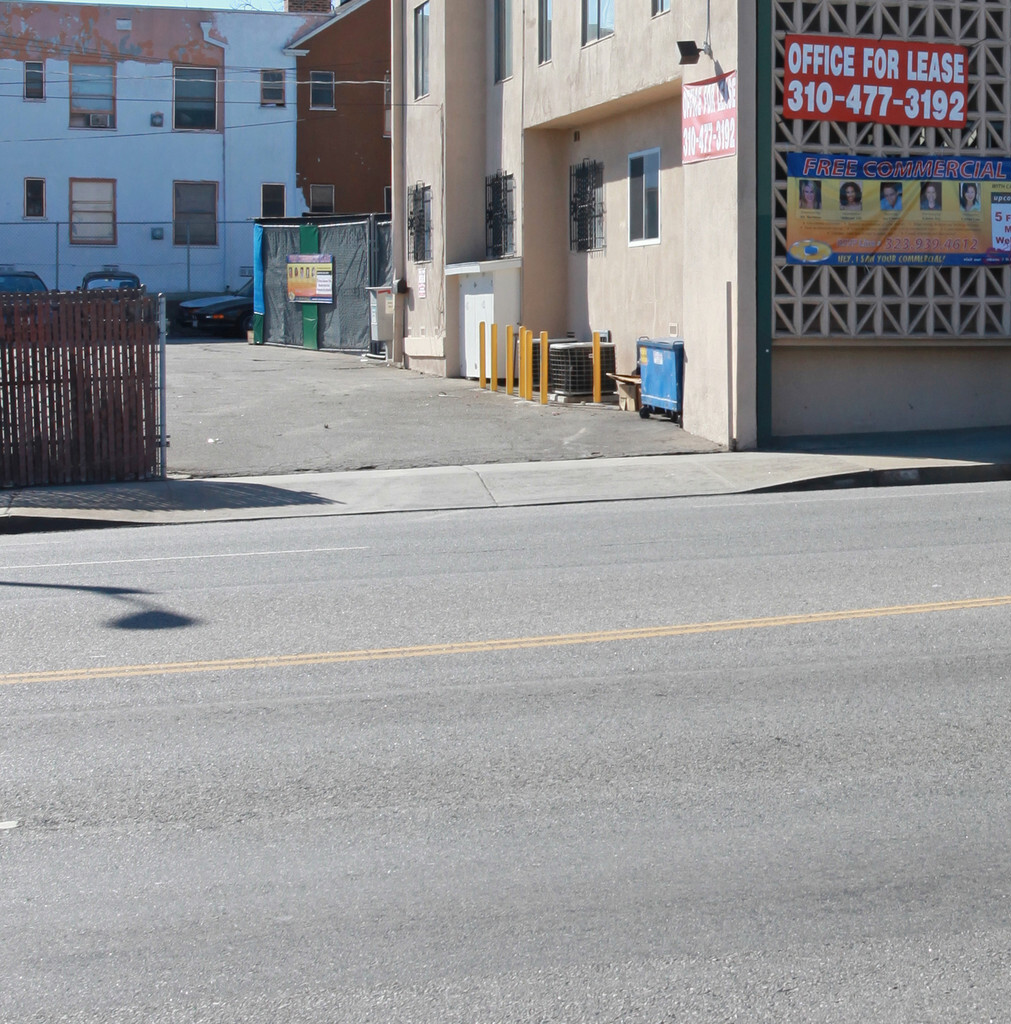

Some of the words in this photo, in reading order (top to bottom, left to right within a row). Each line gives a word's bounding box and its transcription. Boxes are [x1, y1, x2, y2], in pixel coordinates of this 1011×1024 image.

[788, 42, 856, 77] OFFICE
[863, 47, 899, 79] FOR
[907, 50, 965, 84] LEASE
[787, 79, 965, 122] 310-477-3192
[683, 117, 736, 158] 310-477-3192
[803, 157, 859, 177] FREE
[862, 160, 1007, 180] COMMERCIAL
[995, 211, 1003, 222] 5
[885, 238, 979, 251] 323.939.4612
[877, 255, 897, 263] YOUR
